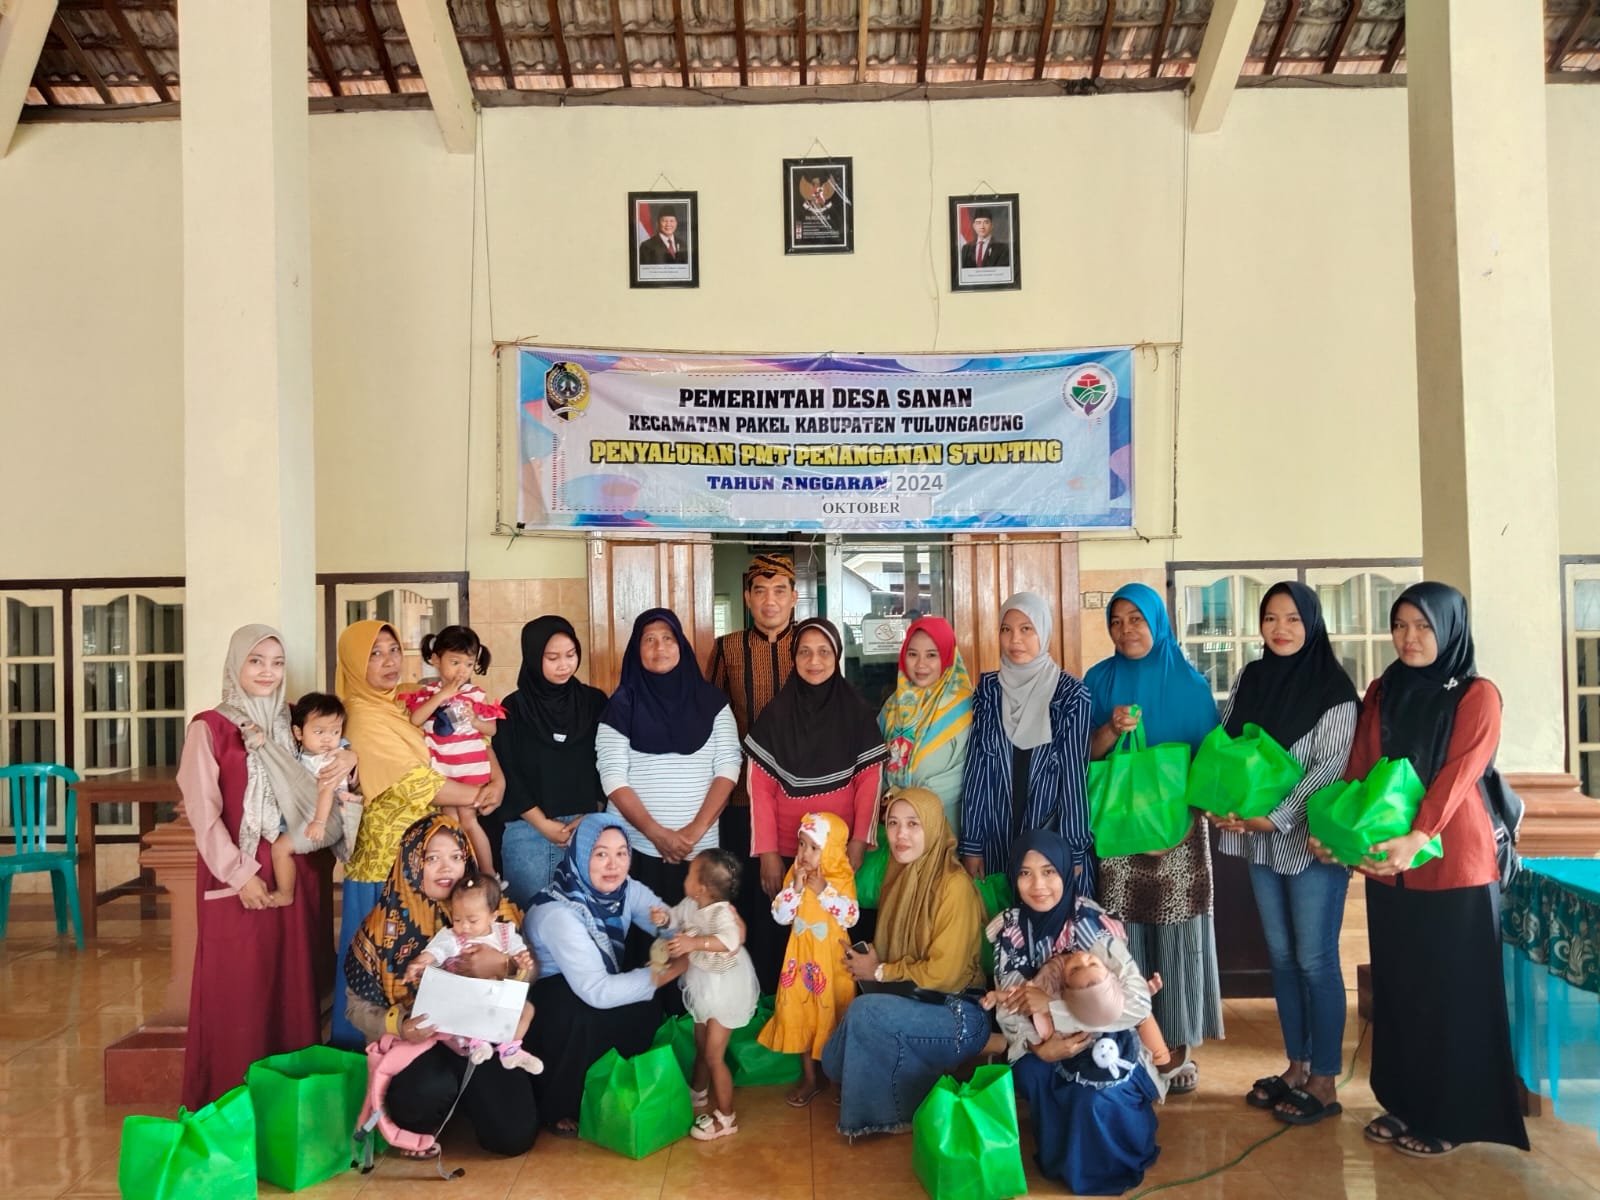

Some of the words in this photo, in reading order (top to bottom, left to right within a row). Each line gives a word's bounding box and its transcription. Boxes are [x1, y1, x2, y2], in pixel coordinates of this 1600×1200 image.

[680, 388, 825, 408] PEMERINTAH
[832, 388, 890, 408] DESA
[897, 388, 972, 408] SANAN
[628, 414, 730, 433] KECAMATAN
[736, 415, 789, 433] PAKEL
[796, 415, 895, 433] KABUPATEN
[901, 414, 1023, 432] TULUNGAGUNG
[590, 440, 736, 464] PENYALURAN
[739, 443, 790, 465] PMT
[795, 443, 942, 465] PENANGANAN
[947, 439, 1063, 464] STUNTING
[706, 475, 775, 490] TAHUN
[781, 475, 888, 490] ANGGARAN
[896, 474, 944, 491] 2024
[822, 502, 901, 514] OKTOBER
